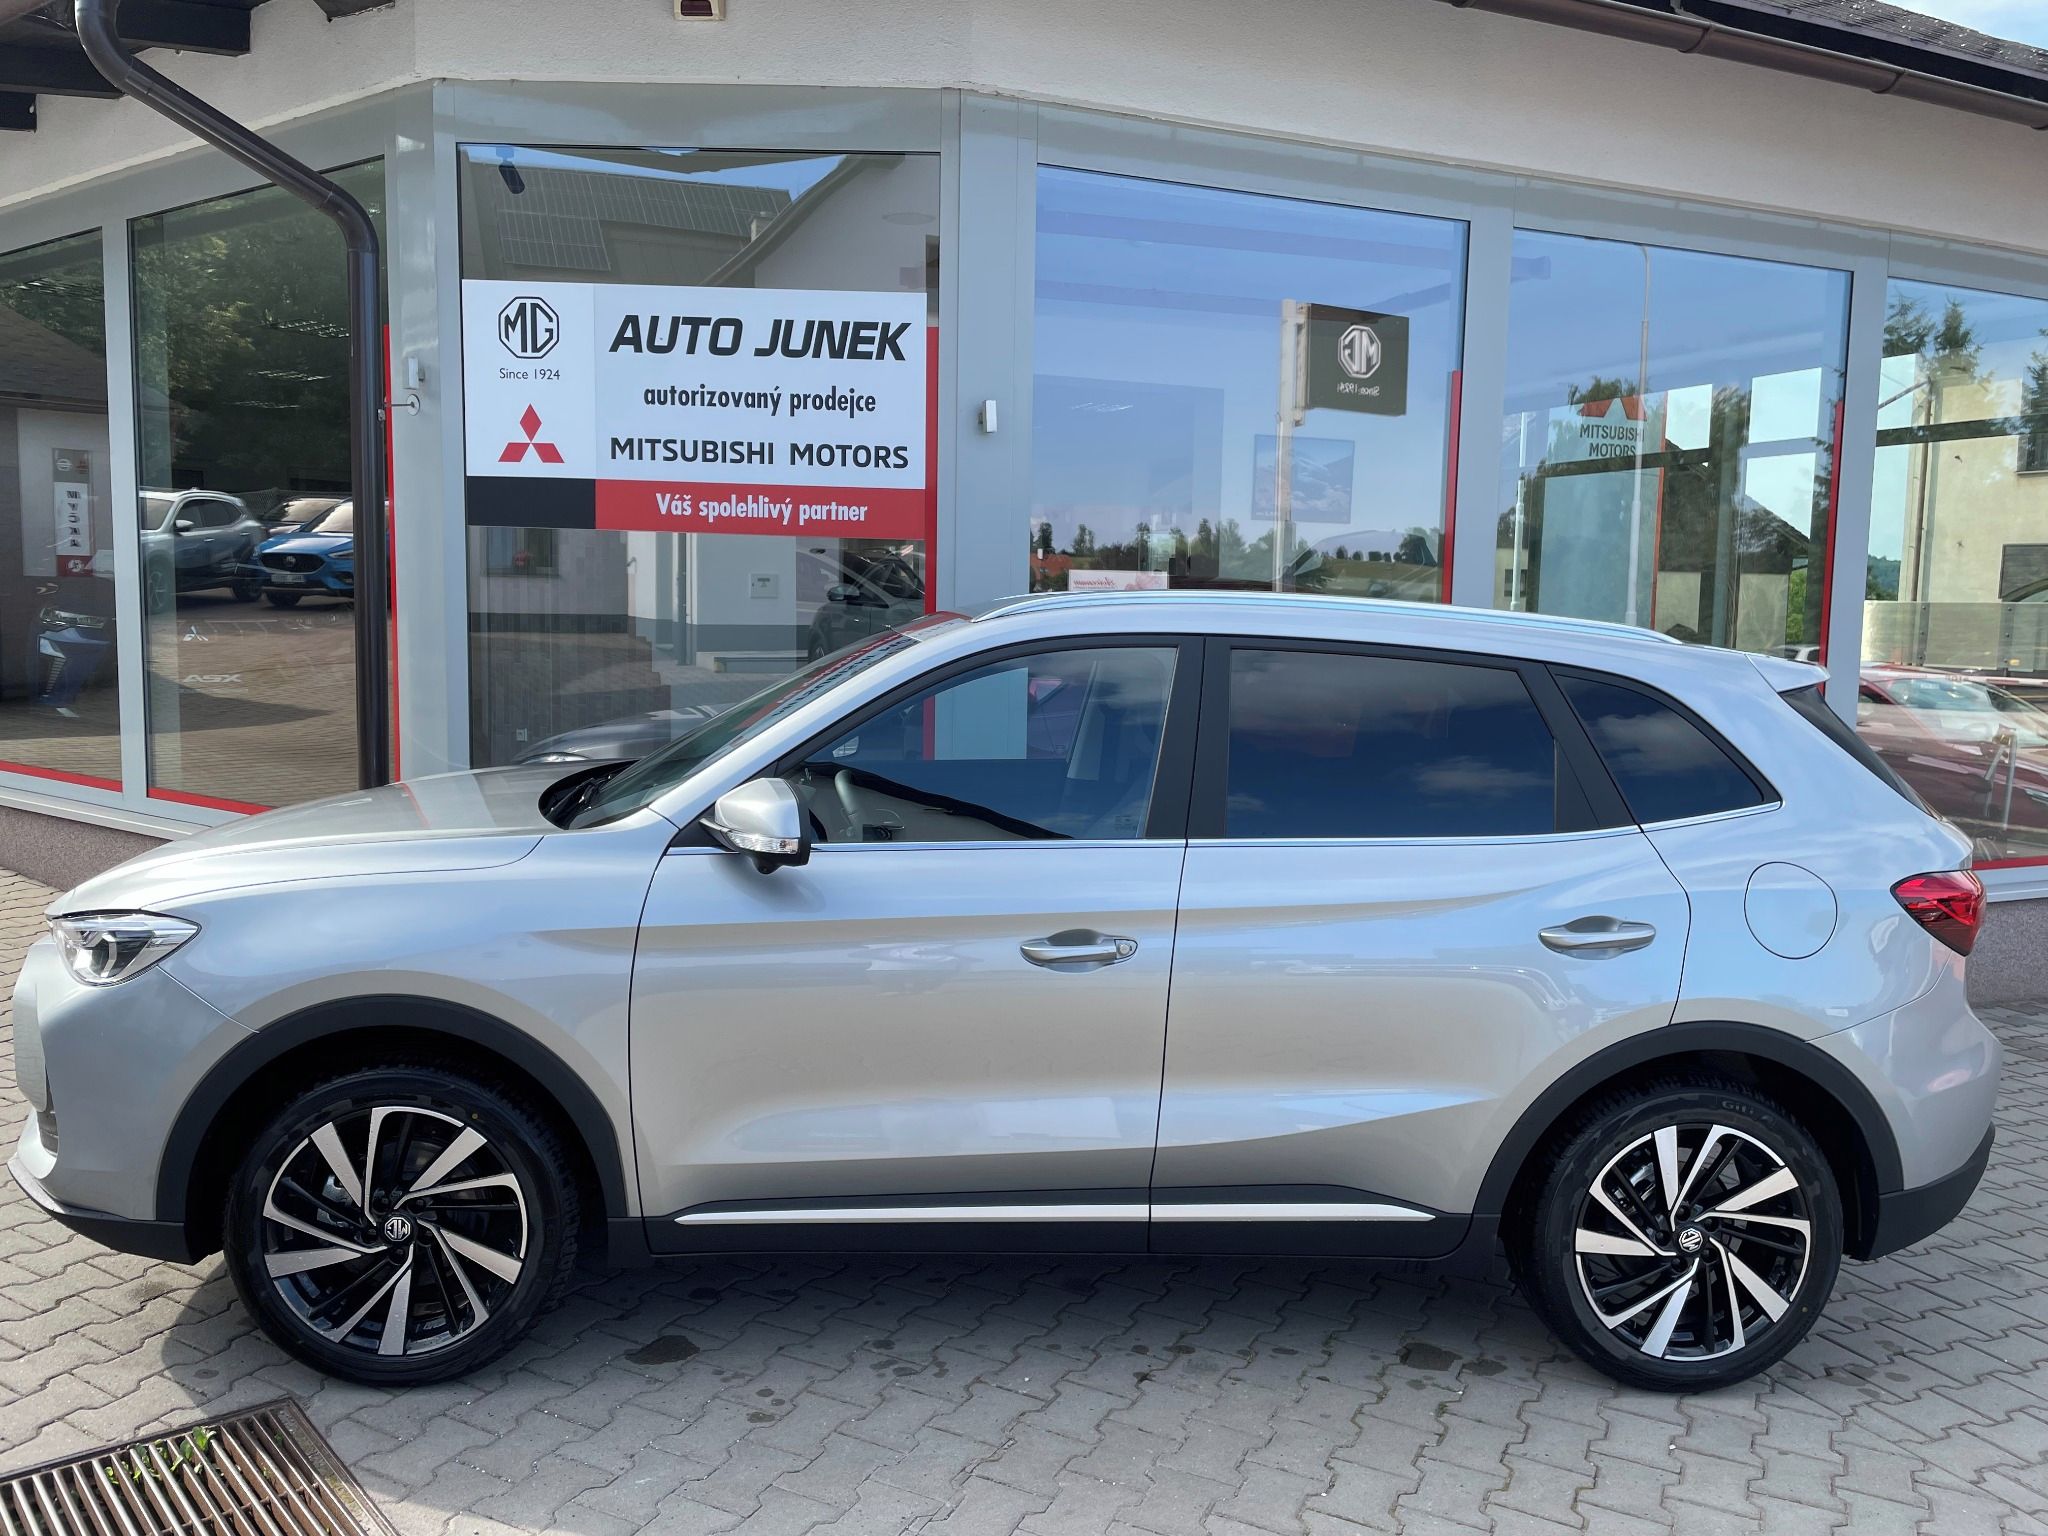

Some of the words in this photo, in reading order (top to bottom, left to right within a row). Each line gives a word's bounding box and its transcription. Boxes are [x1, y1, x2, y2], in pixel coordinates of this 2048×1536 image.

[502, 301, 556, 355] MG
[608, 314, 744, 357] AUTO
[753, 318, 912, 361] JUNEK
[499, 367, 529, 380] Since
[534, 368, 561, 380] 1924
[643, 383, 782, 417] autorizovaný
[789, 385, 876, 419] prodejce
[610, 437, 774, 465] MITSUBISHI
[790, 442, 909, 469] MOTORS
[1588, 442, 1637, 456] MOTORS
[655, 492, 692, 516] Váš
[698, 494, 793, 526] spolehlivý
[799, 501, 868, 526] partner
